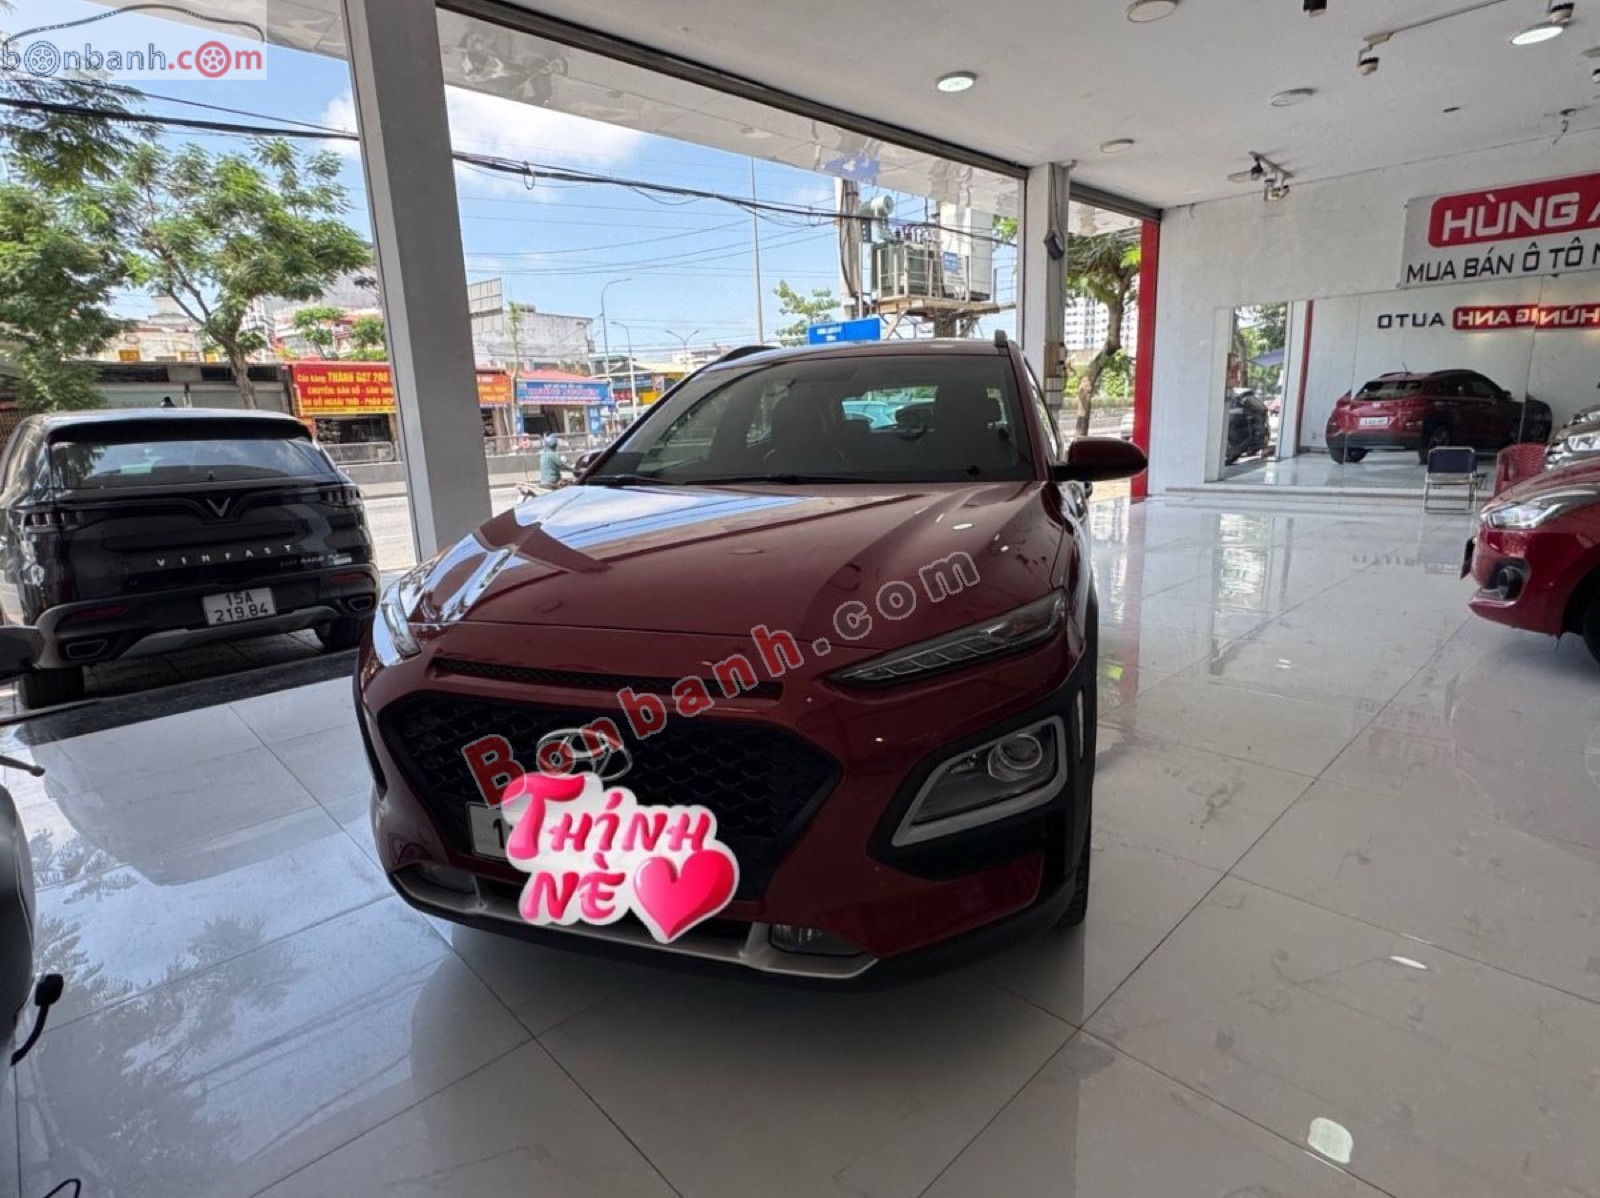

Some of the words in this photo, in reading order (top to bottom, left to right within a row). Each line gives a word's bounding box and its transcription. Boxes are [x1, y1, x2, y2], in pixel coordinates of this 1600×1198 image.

[1441, 192, 1580, 241] HÙNG
[1406, 260, 1456, 284] MUA
[1462, 246, 1515, 278] BÁN
[1522, 241, 1541, 271] Ô
[1549, 236, 1584, 269] TÔ
[156, 544, 292, 567] VINFAST
[224, 592, 253, 606] 15A
[214, 602, 268, 622] 219.84
